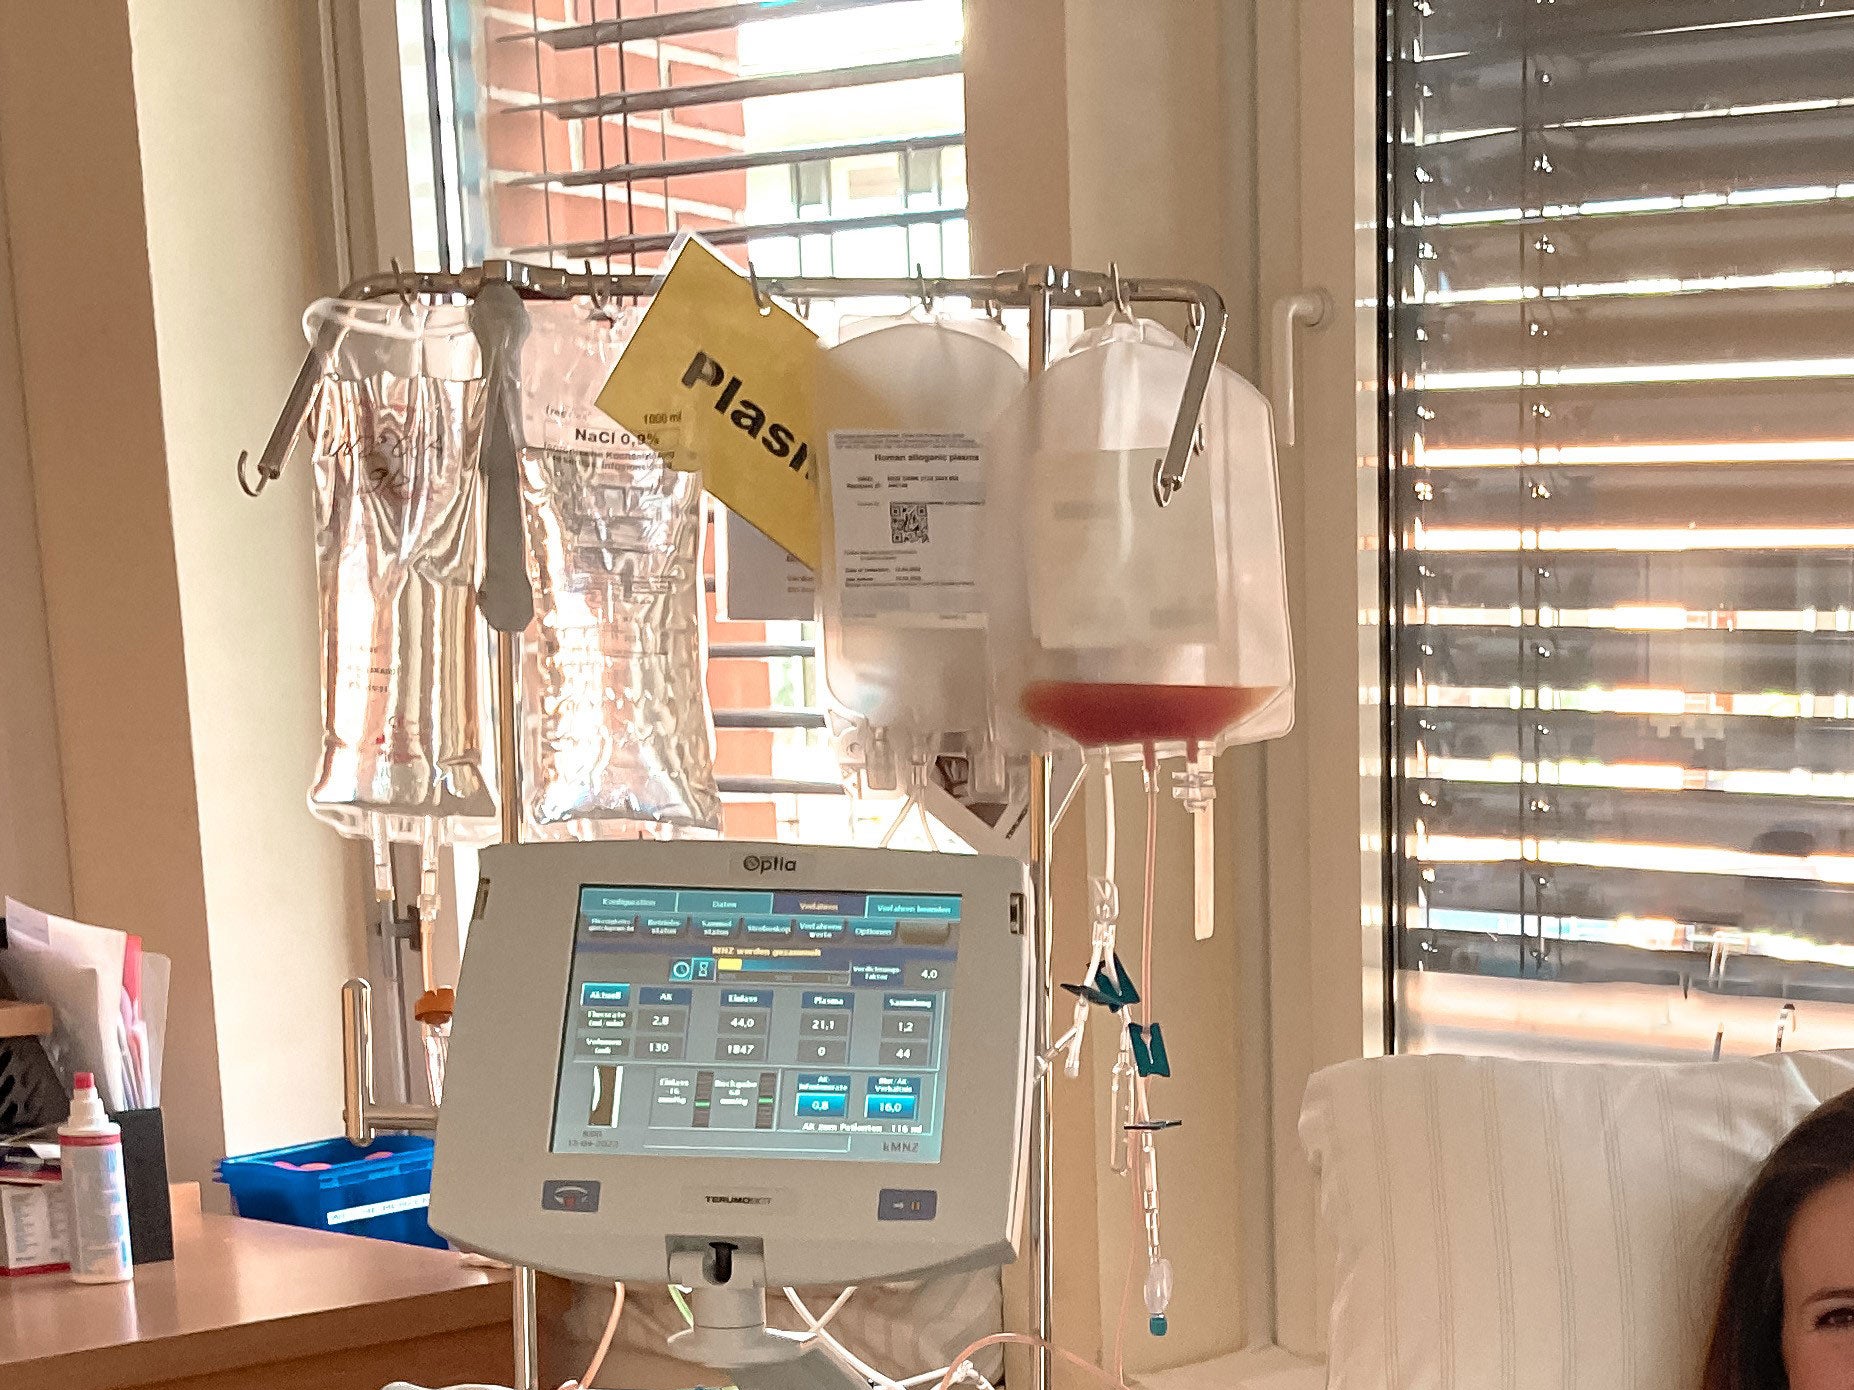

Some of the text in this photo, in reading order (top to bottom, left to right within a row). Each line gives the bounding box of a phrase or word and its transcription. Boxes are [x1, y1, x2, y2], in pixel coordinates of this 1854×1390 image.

[575, 428, 661, 448] NaCl 0,9%
[743, 855, 797, 875] Optia
[813, 996, 844, 1006] Plasma
[649, 1042, 669, 1053] 130
[727, 1044, 754, 1055] 1847
[895, 1048, 912, 1059] 44
